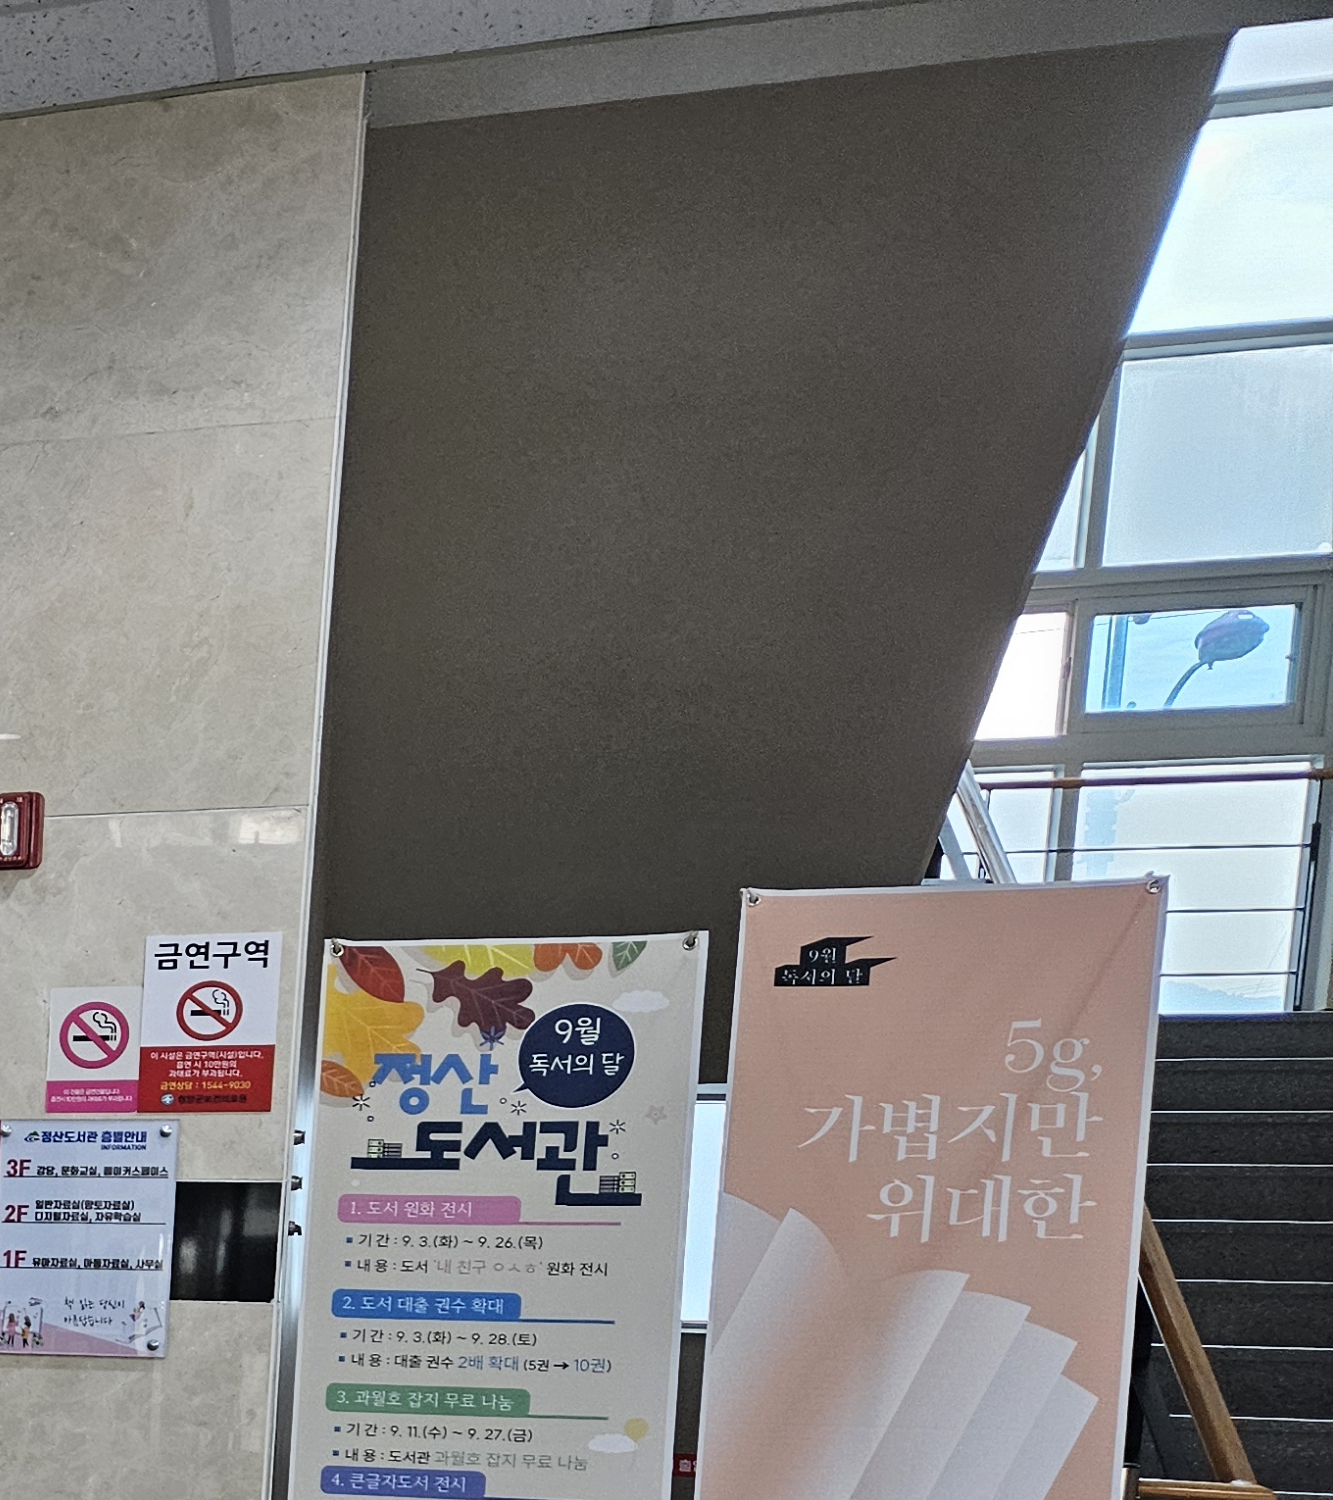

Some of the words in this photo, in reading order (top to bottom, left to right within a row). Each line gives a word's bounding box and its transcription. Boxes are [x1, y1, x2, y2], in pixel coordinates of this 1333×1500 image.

[154, 940, 269, 970] 금연구역
[555, 1017, 601, 1045] 9월
[150, 1052, 158, 1060] 이
[529, 1053, 594, 1075] 독서의
[601, 1052, 624, 1075] 달
[1004, 1018, 1102, 1092] 5g,
[201, 1080, 251, 1089] 1544-9030
[373, 1053, 499, 1115] 정산
[798, 1091, 1103, 1161] 가볍지만
[41, 1131, 98, 1143] 정산도서관
[101, 1131, 147, 1143] 층별안내
[6, 1159, 31, 1177] 3F
[351, 1121, 642, 1206] 도서관
[5, 1205, 29, 1222] 2F
[350, 1202, 362, 1215] 1.
[367, 1202, 398, 1217] 도서
[404, 1202, 435, 1217] 원화
[441, 1202, 472, 1217] 전시
[866, 1174, 1097, 1243] 위대한
[4, 1250, 27, 1267] 1F
[343, 1297, 356, 1310] 2.
[360, 1297, 392, 1311] 도서
[398, 1298, 430, 1313] 대출
[435, 1298, 466, 1314] 권수
[471, 1299, 504, 1314] 확대
[331, 1474, 344, 1487] 4.
[349, 1473, 429, 1490] 큰글자도서
[434, 1477, 466, 1492] 전시
